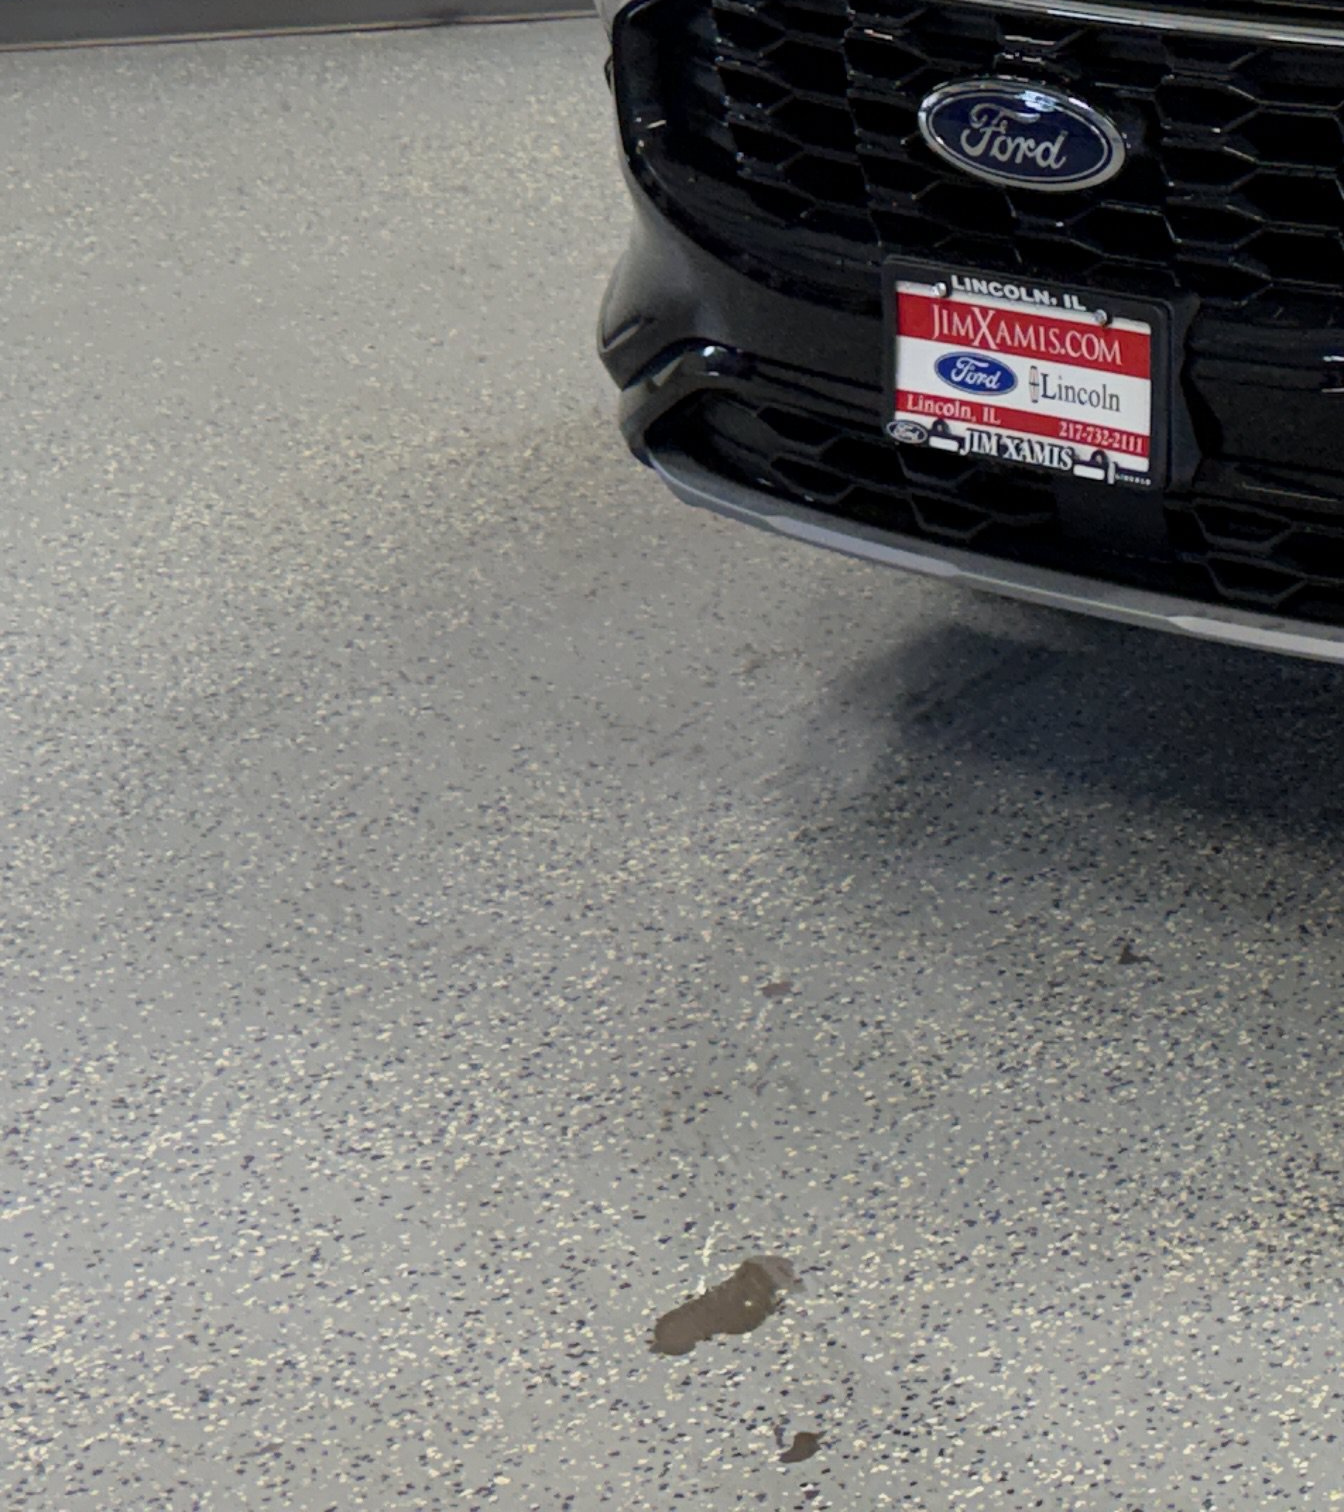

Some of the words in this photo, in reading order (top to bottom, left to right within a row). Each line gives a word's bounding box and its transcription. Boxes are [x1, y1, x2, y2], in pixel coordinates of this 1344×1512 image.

[961, 102, 1068, 170] Ford
[1063, 294, 1087, 311] IL
[951, 356, 1001, 390] Ford
[907, 393, 977, 423] Lincoln,
[982, 407, 1000, 425] IL
[1041, 373, 1121, 412] Lincoln
[959, 428, 999, 456] JIM
[1003, 436, 1074, 471] XAMIS
